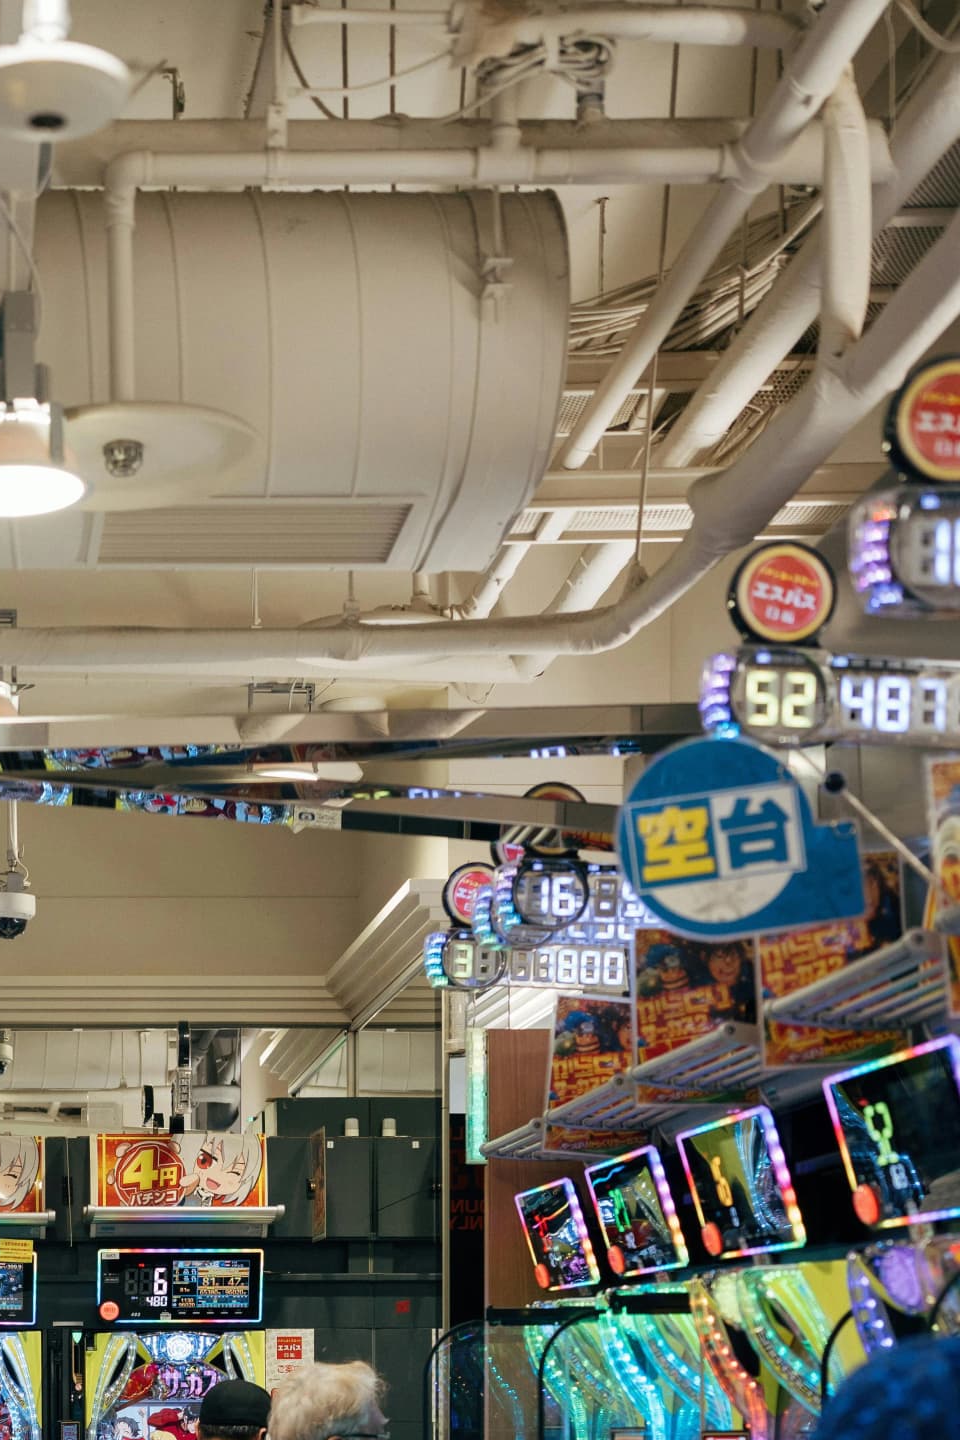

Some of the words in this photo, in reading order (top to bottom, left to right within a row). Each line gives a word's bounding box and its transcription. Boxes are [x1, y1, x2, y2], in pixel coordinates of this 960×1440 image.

[751, 581, 817, 611] エスパス
[745, 670, 817, 729] 52
[840, 675, 946, 733] 487
[636, 796, 790, 884] 空台
[540, 875, 577, 917] 16
[123, 1149, 178, 1191] 4円
[129, 1190, 178, 1206] パチンコ
[153, 1267, 168, 1296] 6
[145, 1296, 168, 1308] 480
[277, 1343, 302, 1351] エスパス
